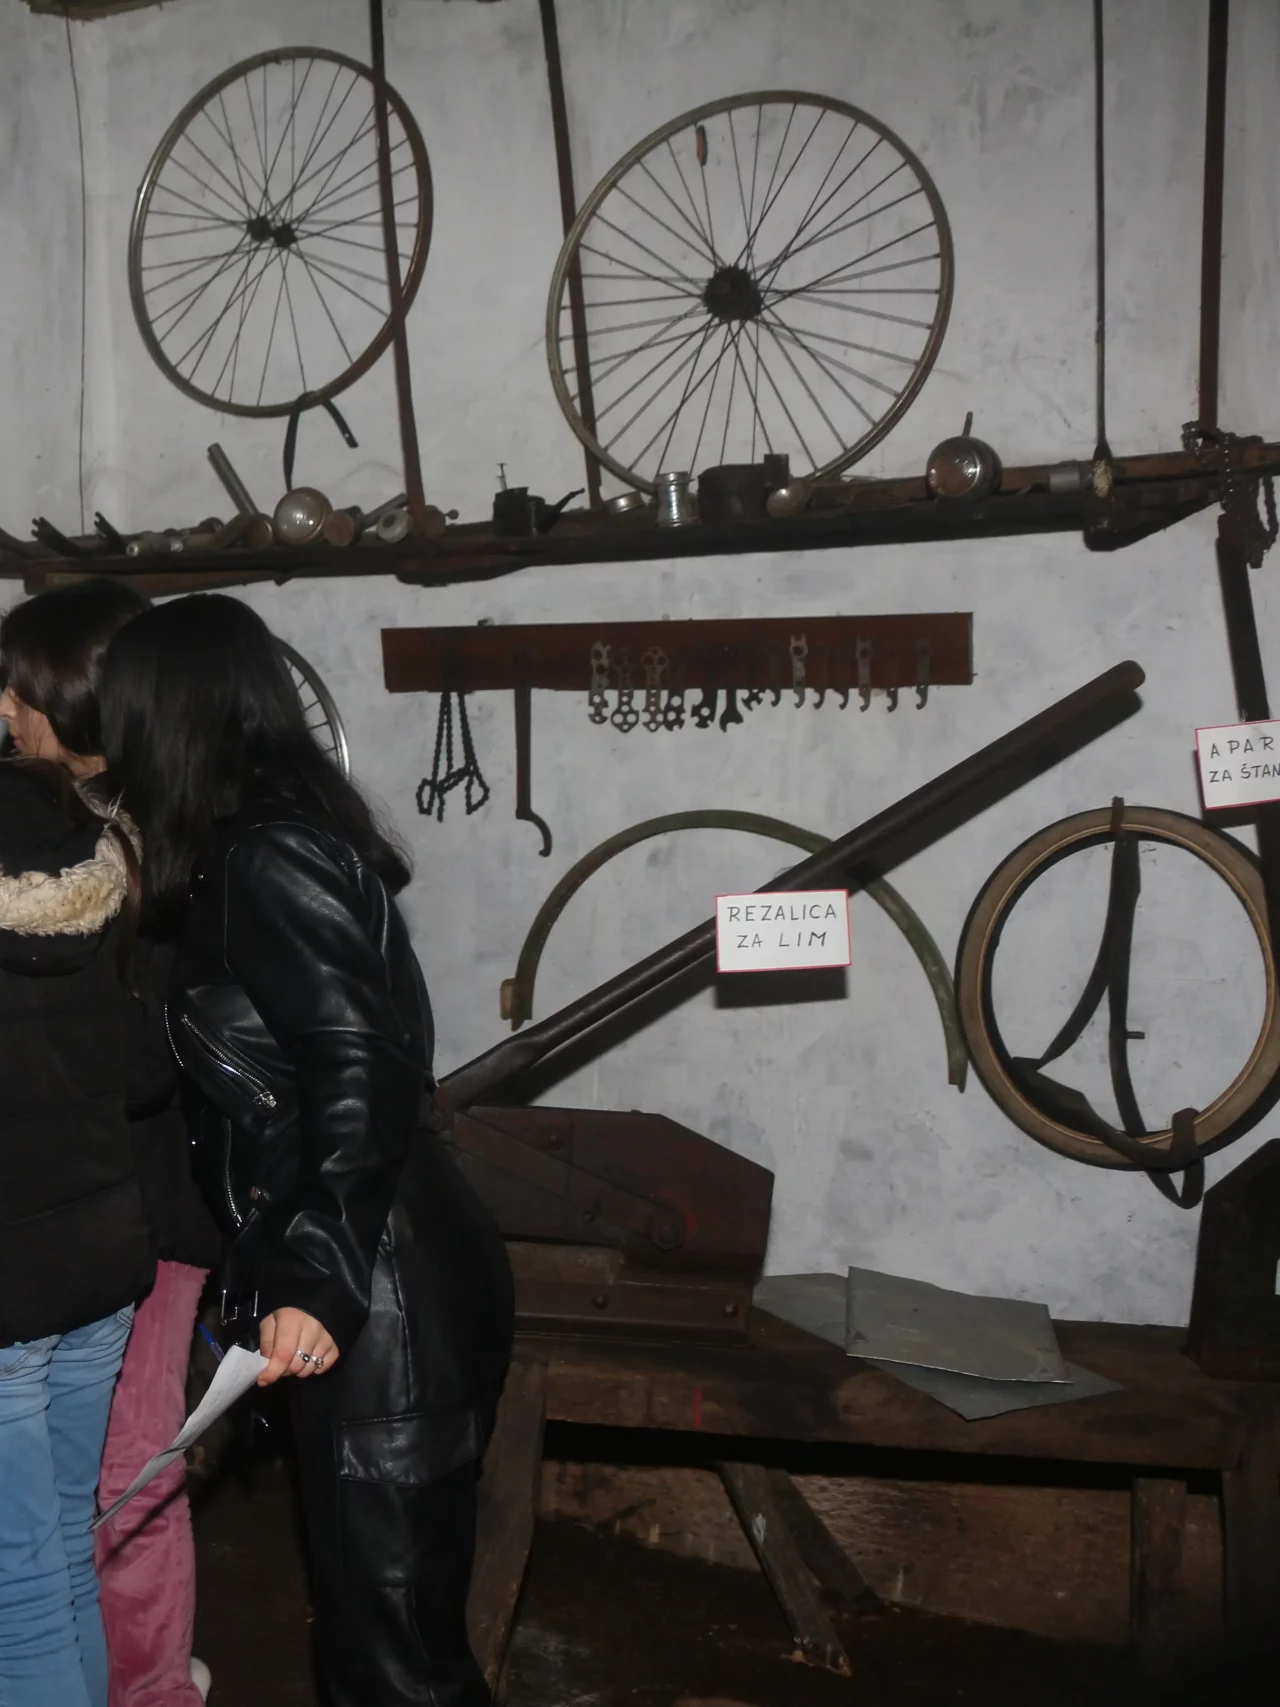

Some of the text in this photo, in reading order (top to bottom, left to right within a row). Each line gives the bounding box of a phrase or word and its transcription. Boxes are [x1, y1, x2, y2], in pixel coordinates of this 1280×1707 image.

[1210, 736, 1275, 759] APAR
[1209, 763, 1280, 783] ZA ŠTAN
[727, 903, 837, 922] REZALICA
[736, 931, 827, 948] ZA LIM
